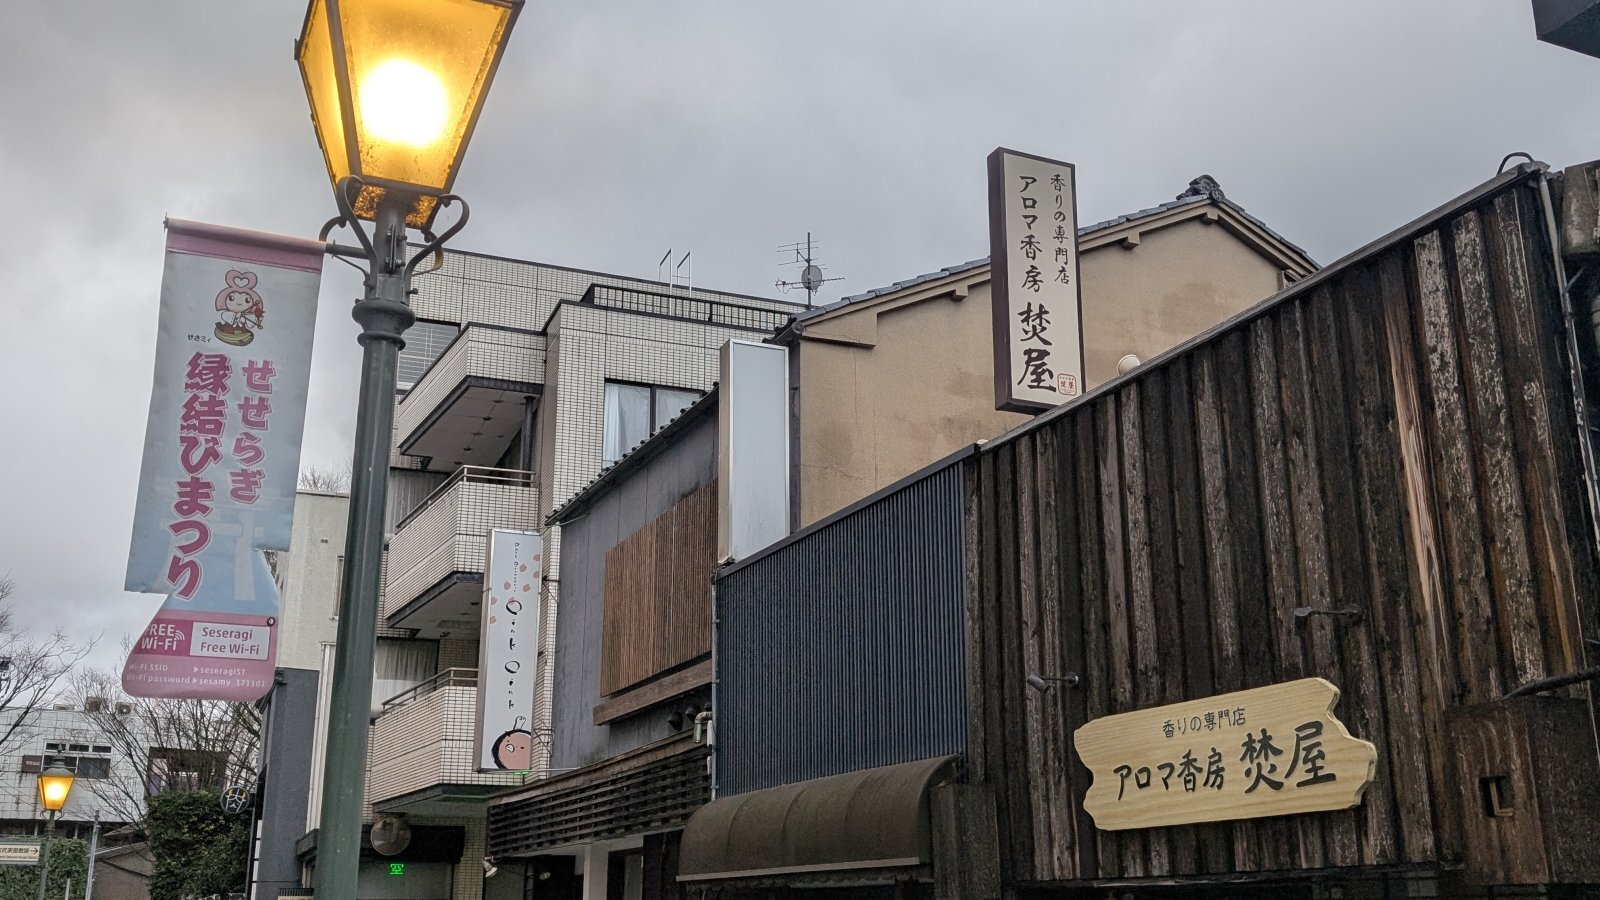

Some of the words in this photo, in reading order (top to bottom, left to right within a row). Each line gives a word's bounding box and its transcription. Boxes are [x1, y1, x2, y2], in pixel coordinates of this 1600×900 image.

[1018, 175, 1044, 293] アロマ香房
[1050, 173, 1070, 285] 香りの専門店
[228, 359, 277, 505] せせらぎ
[166, 351, 232, 600] 縁結びまつり
[141, 636, 178, 651] Wi-Fi
[200, 642, 226, 653] Free
[229, 643, 260, 655] Wi-Fi
[202, 626, 253, 641] Seseragi
[147, 676, 190, 684] password
[1162, 707, 1246, 738] 香りの専門店
[1113, 747, 1225, 801] アロマ香房
[390, 863, 404, 875] 空
